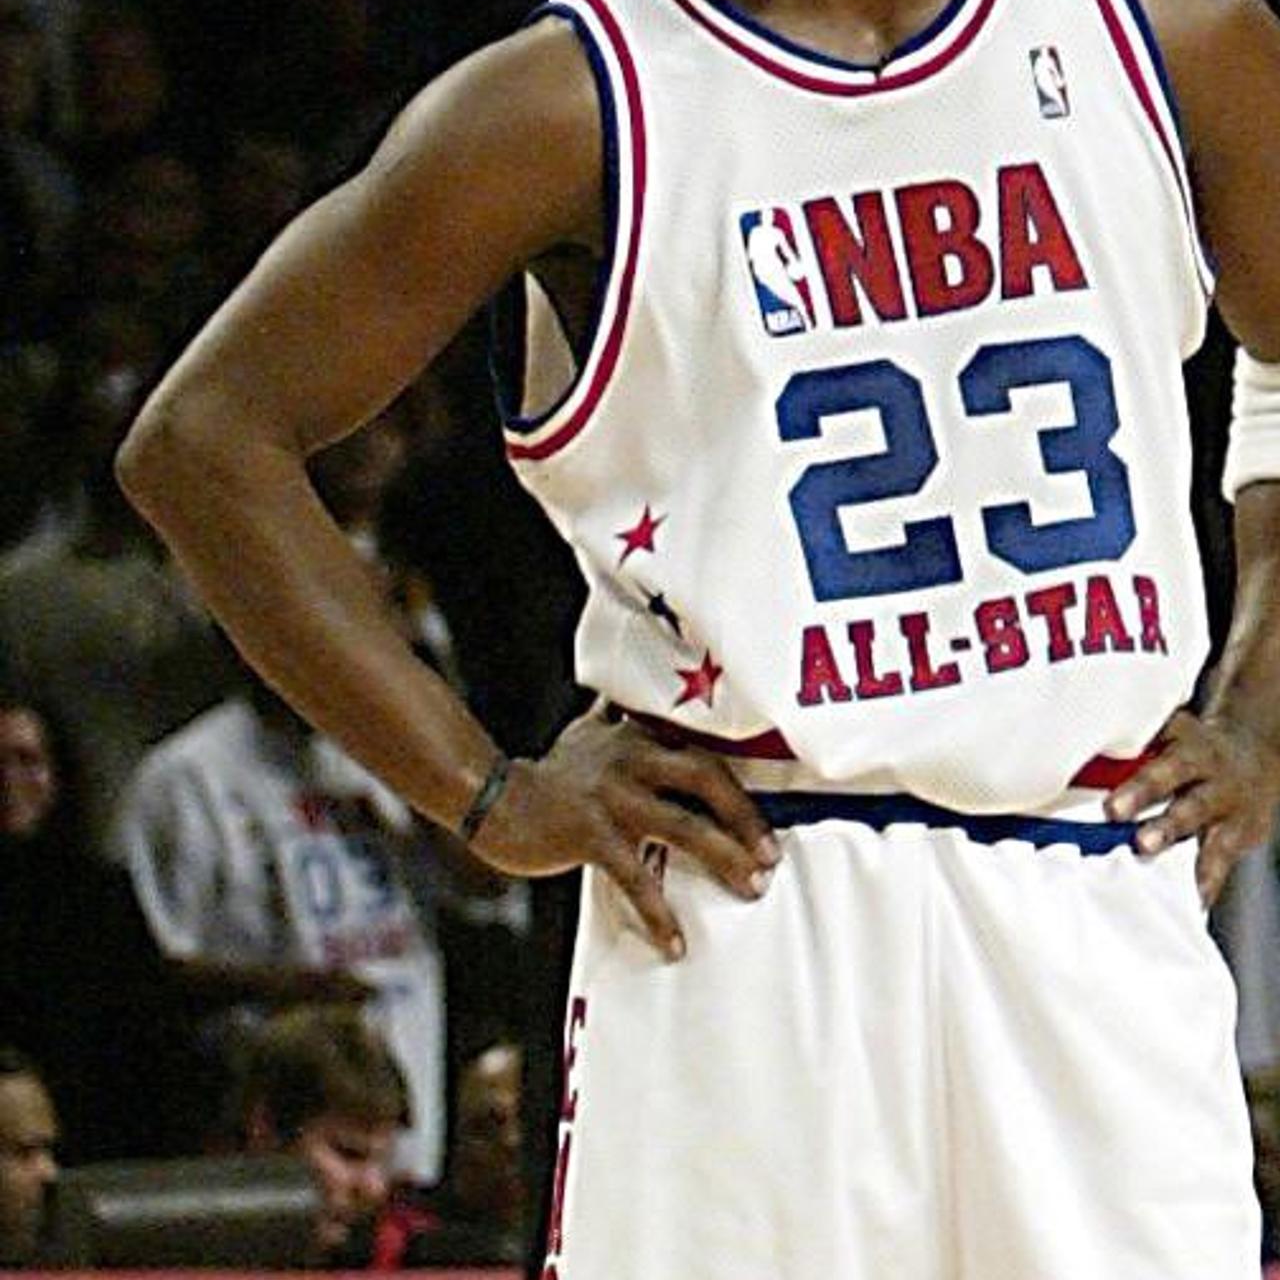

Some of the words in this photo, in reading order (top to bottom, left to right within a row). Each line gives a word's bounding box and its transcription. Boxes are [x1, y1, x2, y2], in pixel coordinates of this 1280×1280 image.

[801, 162, 1088, 329] NBA
[773, 334, 1137, 603] 23
[796, 574, 1168, 707] ALL-STAR
